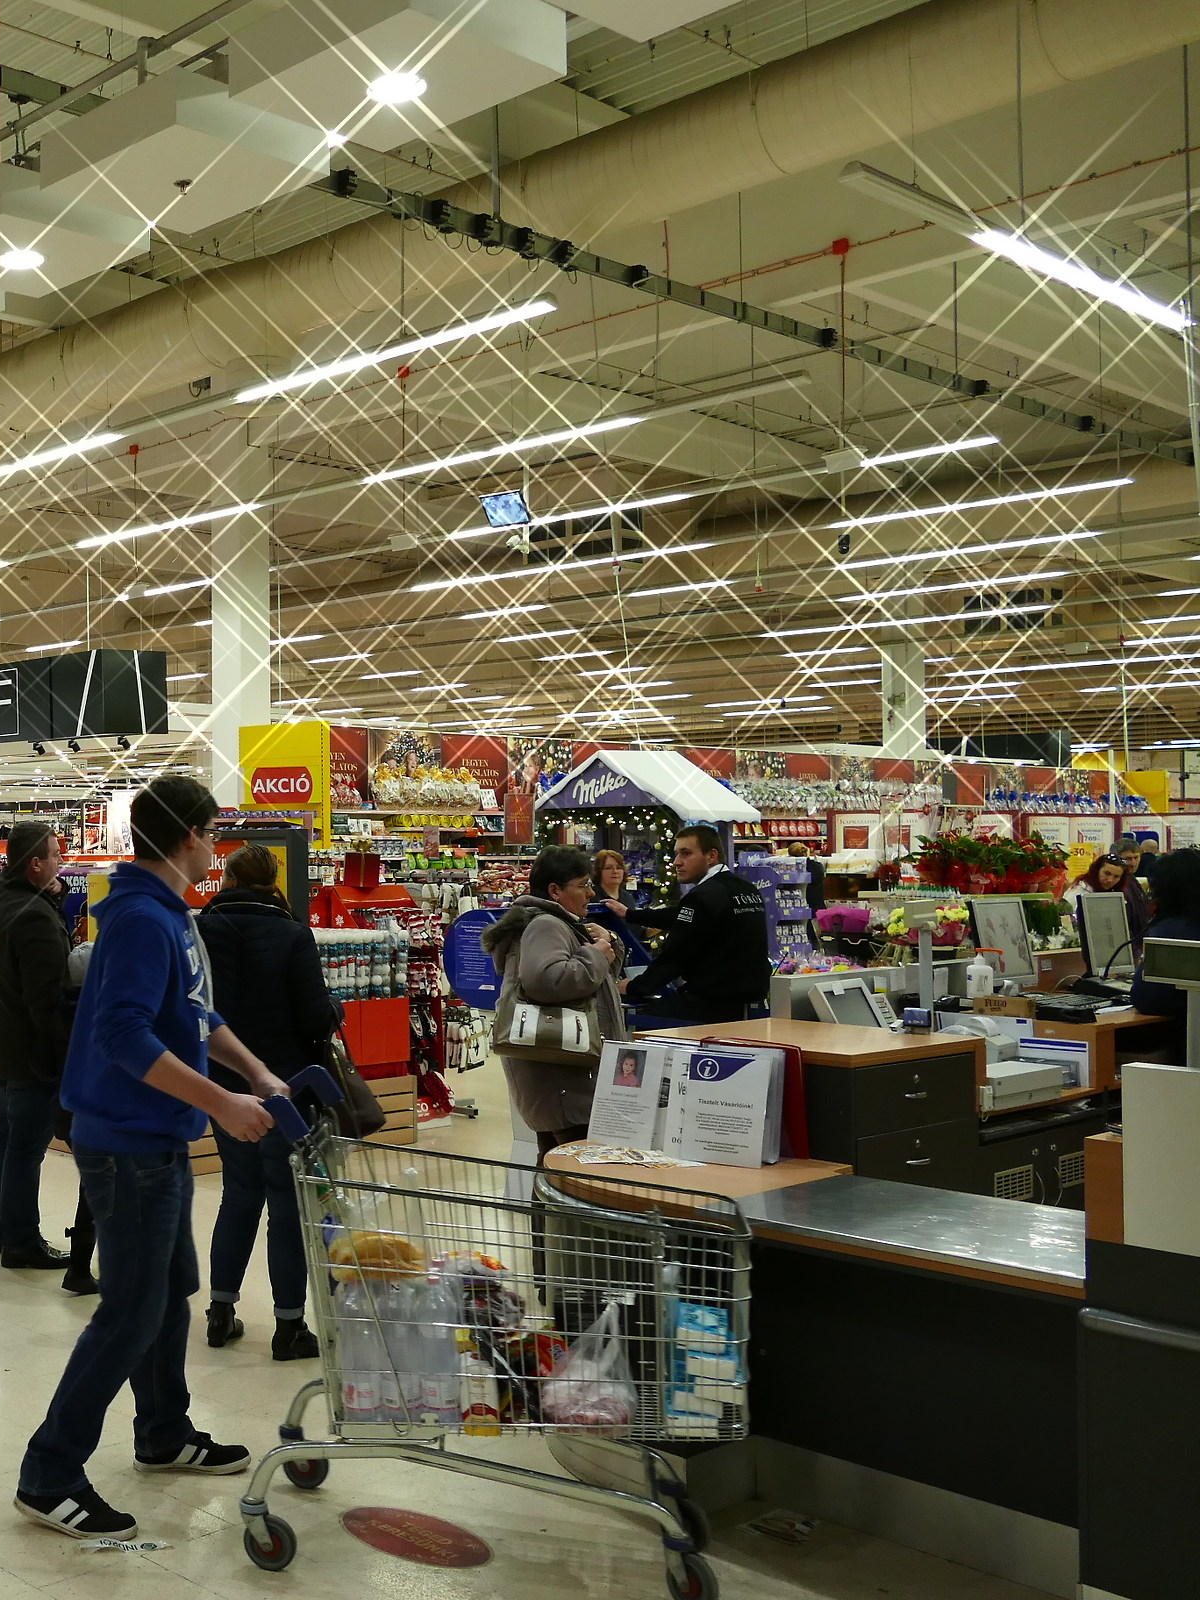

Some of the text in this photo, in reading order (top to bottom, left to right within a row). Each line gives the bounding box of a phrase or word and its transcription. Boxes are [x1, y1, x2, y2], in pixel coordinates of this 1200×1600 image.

[329, 752, 346, 761] YEN
[329, 762, 358, 772] SLATOS
[462, 759, 489, 768] LEGYEN
[253, 773, 311, 793] AKCIÓ
[572, 771, 629, 805] Milka
